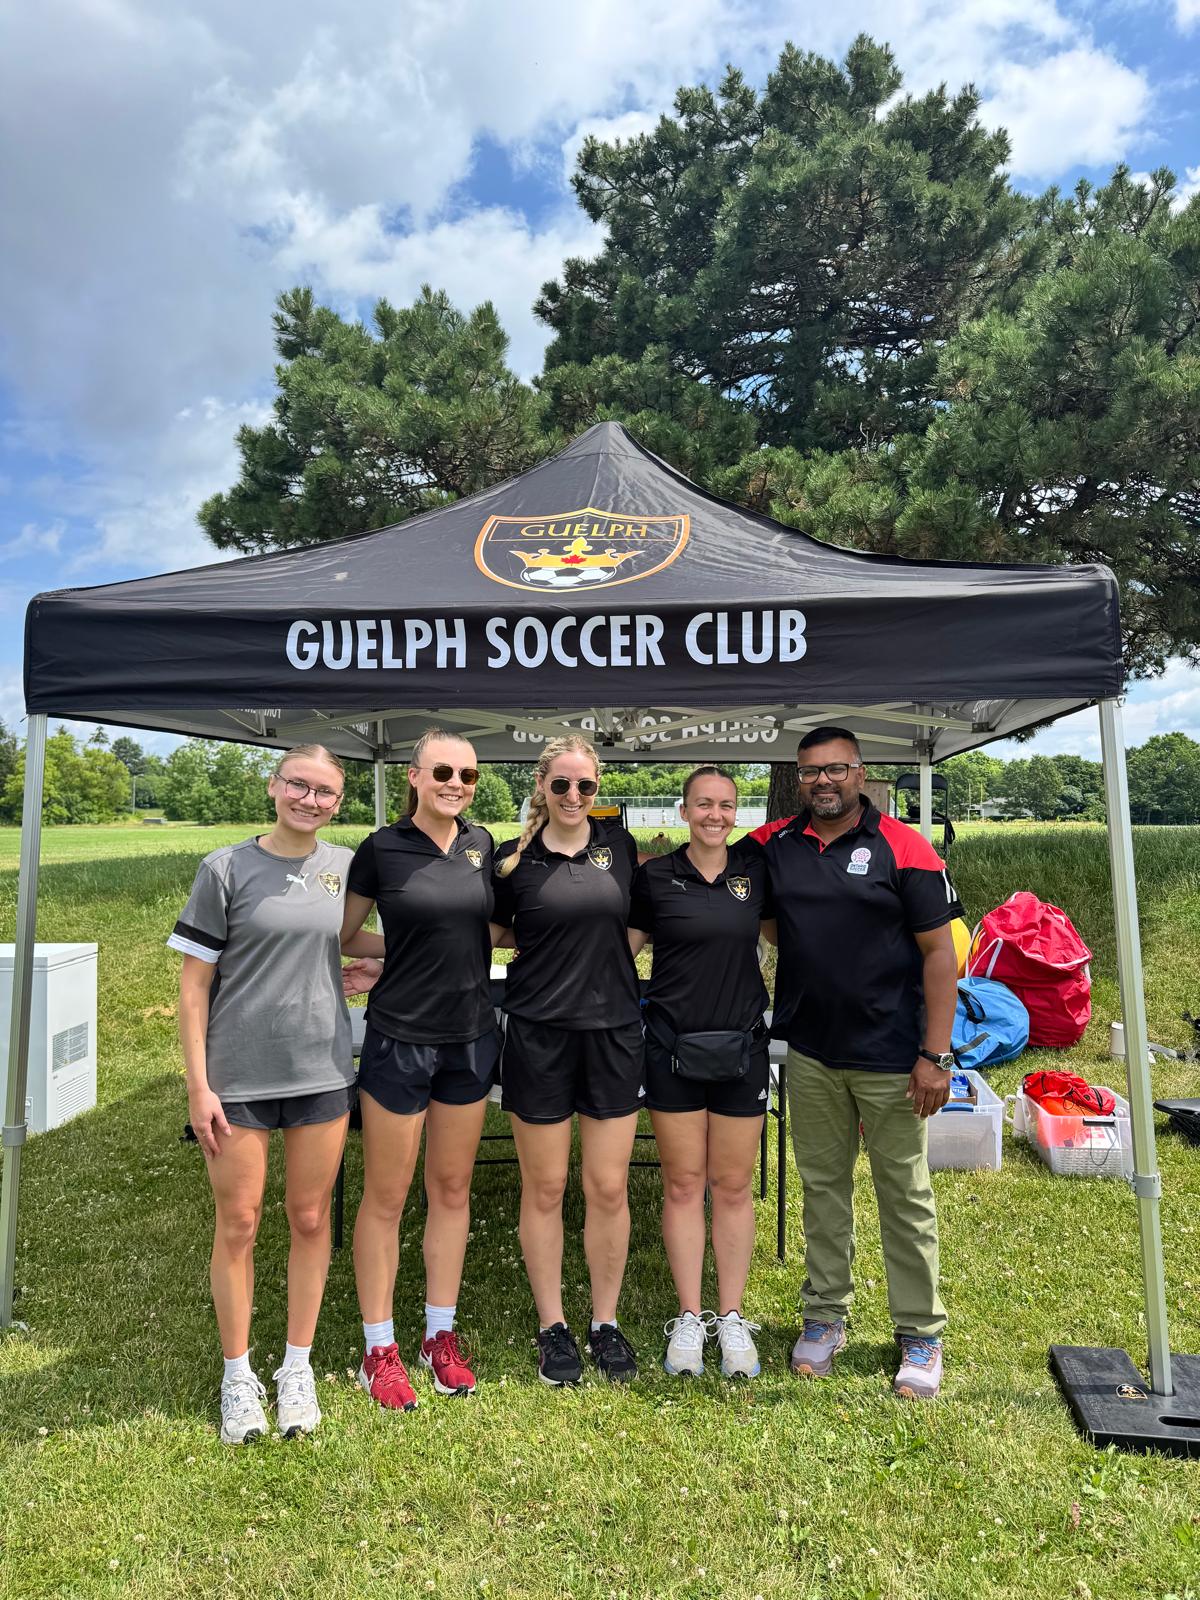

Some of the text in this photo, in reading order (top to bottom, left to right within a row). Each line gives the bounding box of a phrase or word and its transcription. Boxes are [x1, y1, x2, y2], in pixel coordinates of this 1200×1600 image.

[520, 523, 648, 537] GUELPH
[285, 610, 808, 670] GUELPH SOCCER CLUB
